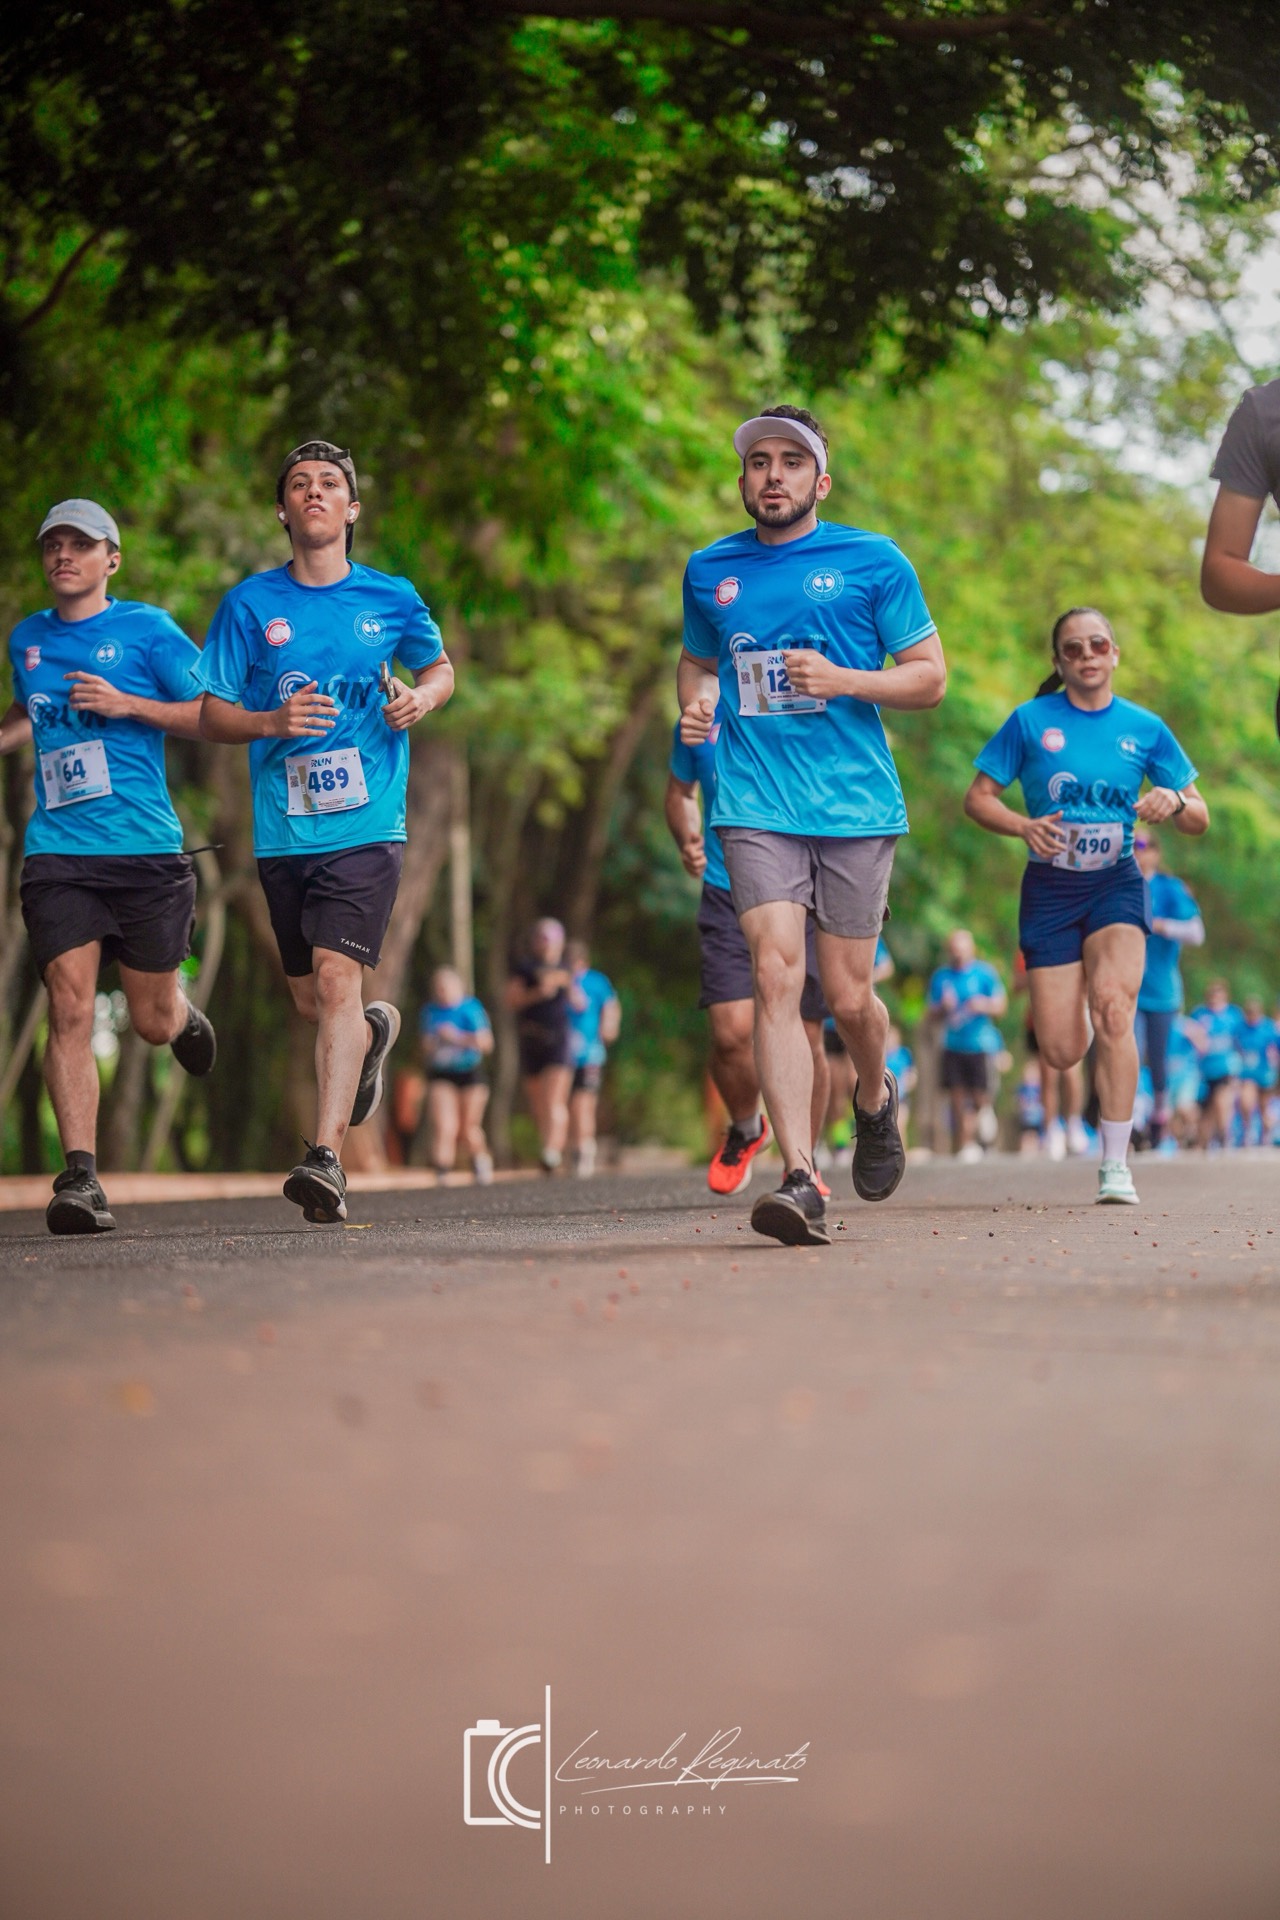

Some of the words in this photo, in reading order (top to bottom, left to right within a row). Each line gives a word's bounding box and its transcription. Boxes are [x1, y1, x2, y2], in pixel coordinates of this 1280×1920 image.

[63, 758, 86, 783] 64
[311, 757, 332, 767] RUN
[308, 767, 349, 793] 489
[1075, 837, 1111, 855] 490
[340, 937, 371, 954] TARMAK
